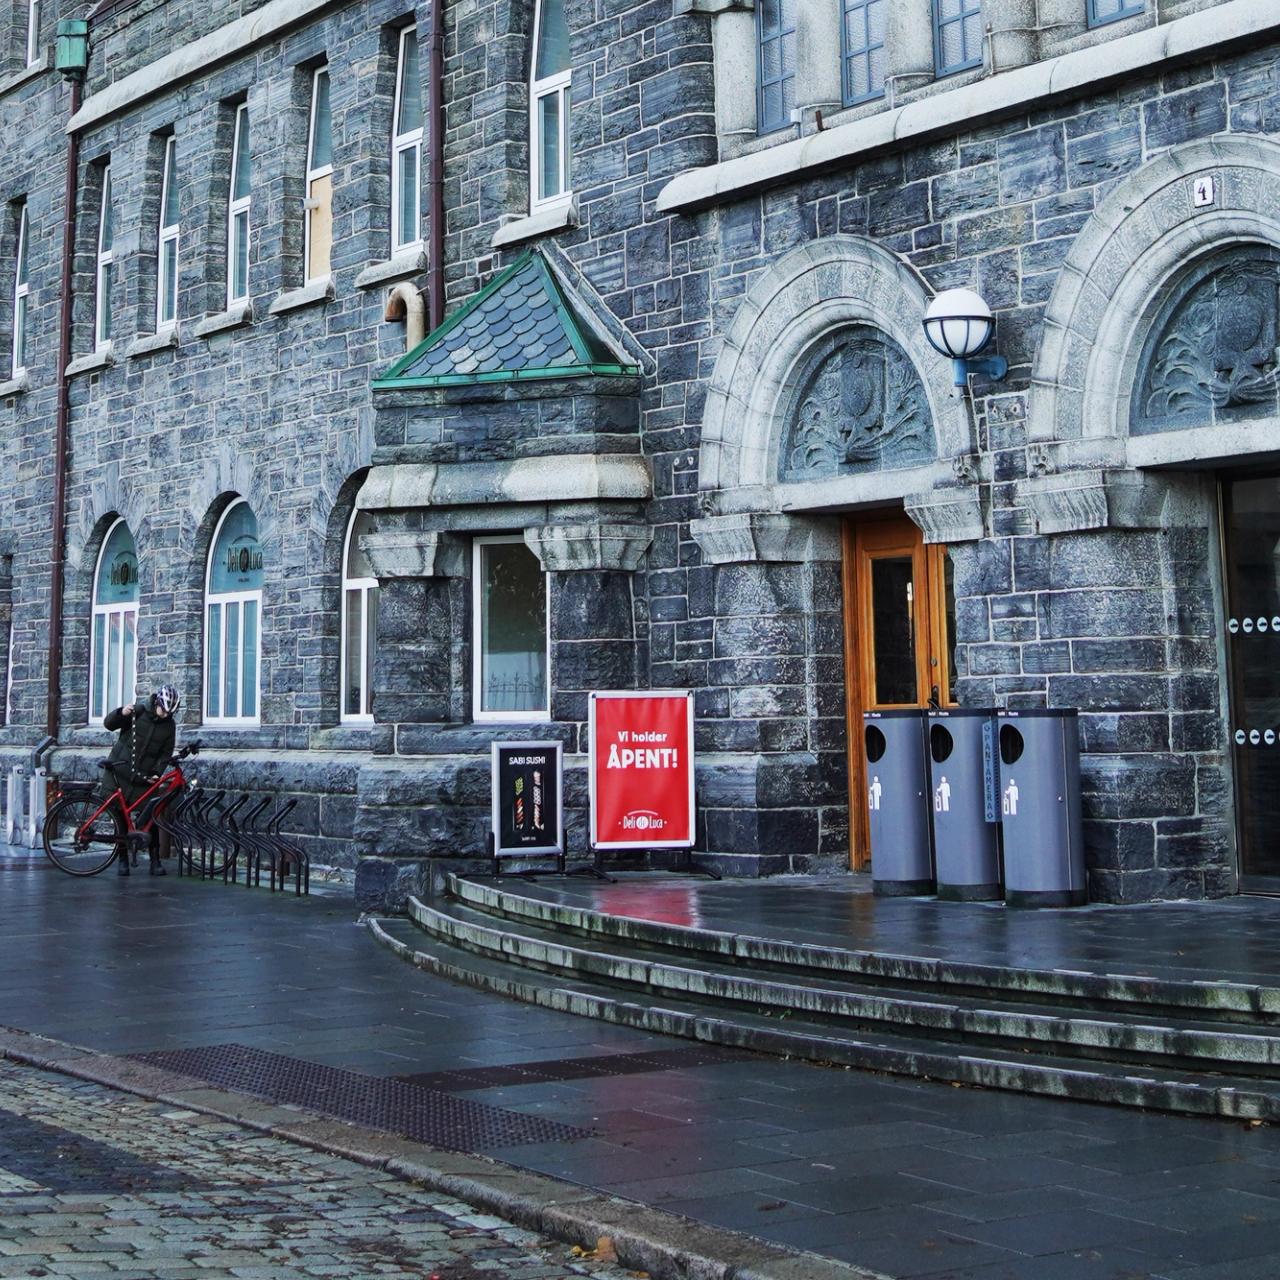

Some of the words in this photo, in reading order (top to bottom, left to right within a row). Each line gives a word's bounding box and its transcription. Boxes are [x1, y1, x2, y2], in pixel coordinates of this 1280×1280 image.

[1198, 182, 1207, 200] 4
[250, 546, 263, 570] Luca
[618, 731, 629, 742] Vi
[631, 731, 668, 742] holder
[509, 757, 525, 765] SABI
[526, 756, 545, 765] SUSHI
[606, 743, 678, 769] ÅPENT!
[623, 815, 636, 829] Deli
[649, 815, 663, 829] Luca
